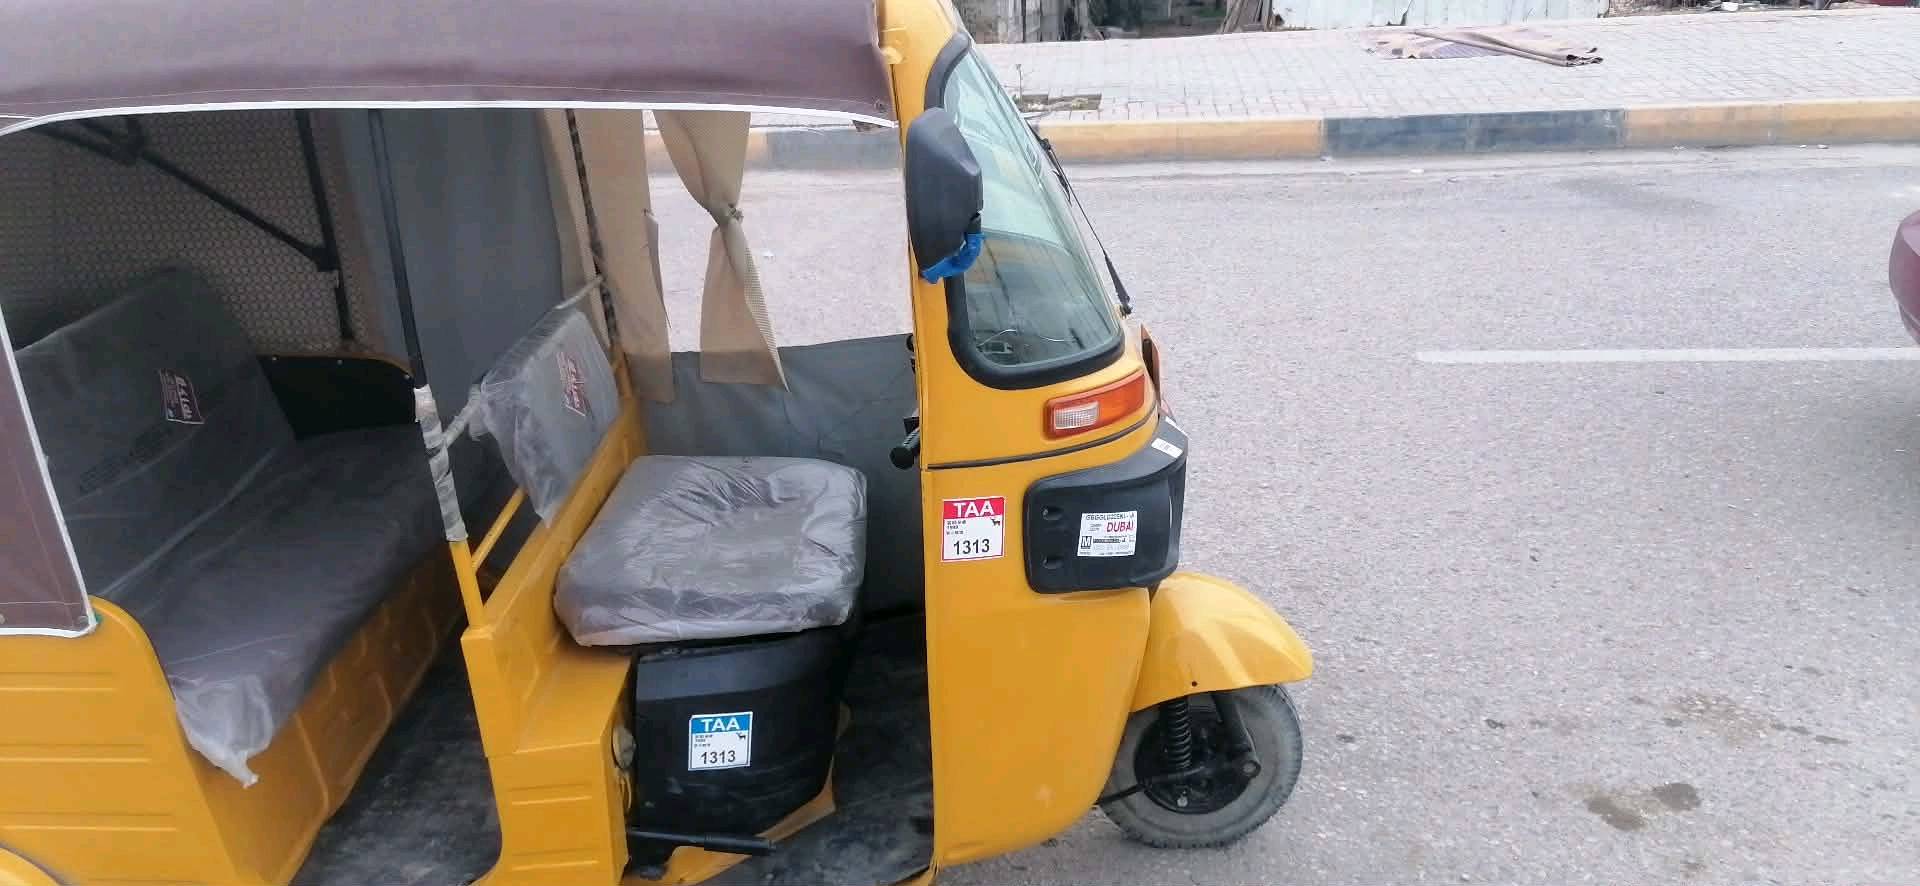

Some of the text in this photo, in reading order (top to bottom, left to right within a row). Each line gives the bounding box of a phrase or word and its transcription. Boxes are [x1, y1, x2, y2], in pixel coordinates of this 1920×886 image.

[953, 501, 995, 517] TAA
[1107, 520, 1134, 532] DUBAI
[954, 539, 990, 555] 1313
[701, 717, 740, 731] TAA
[701, 750, 736, 764] 1313
